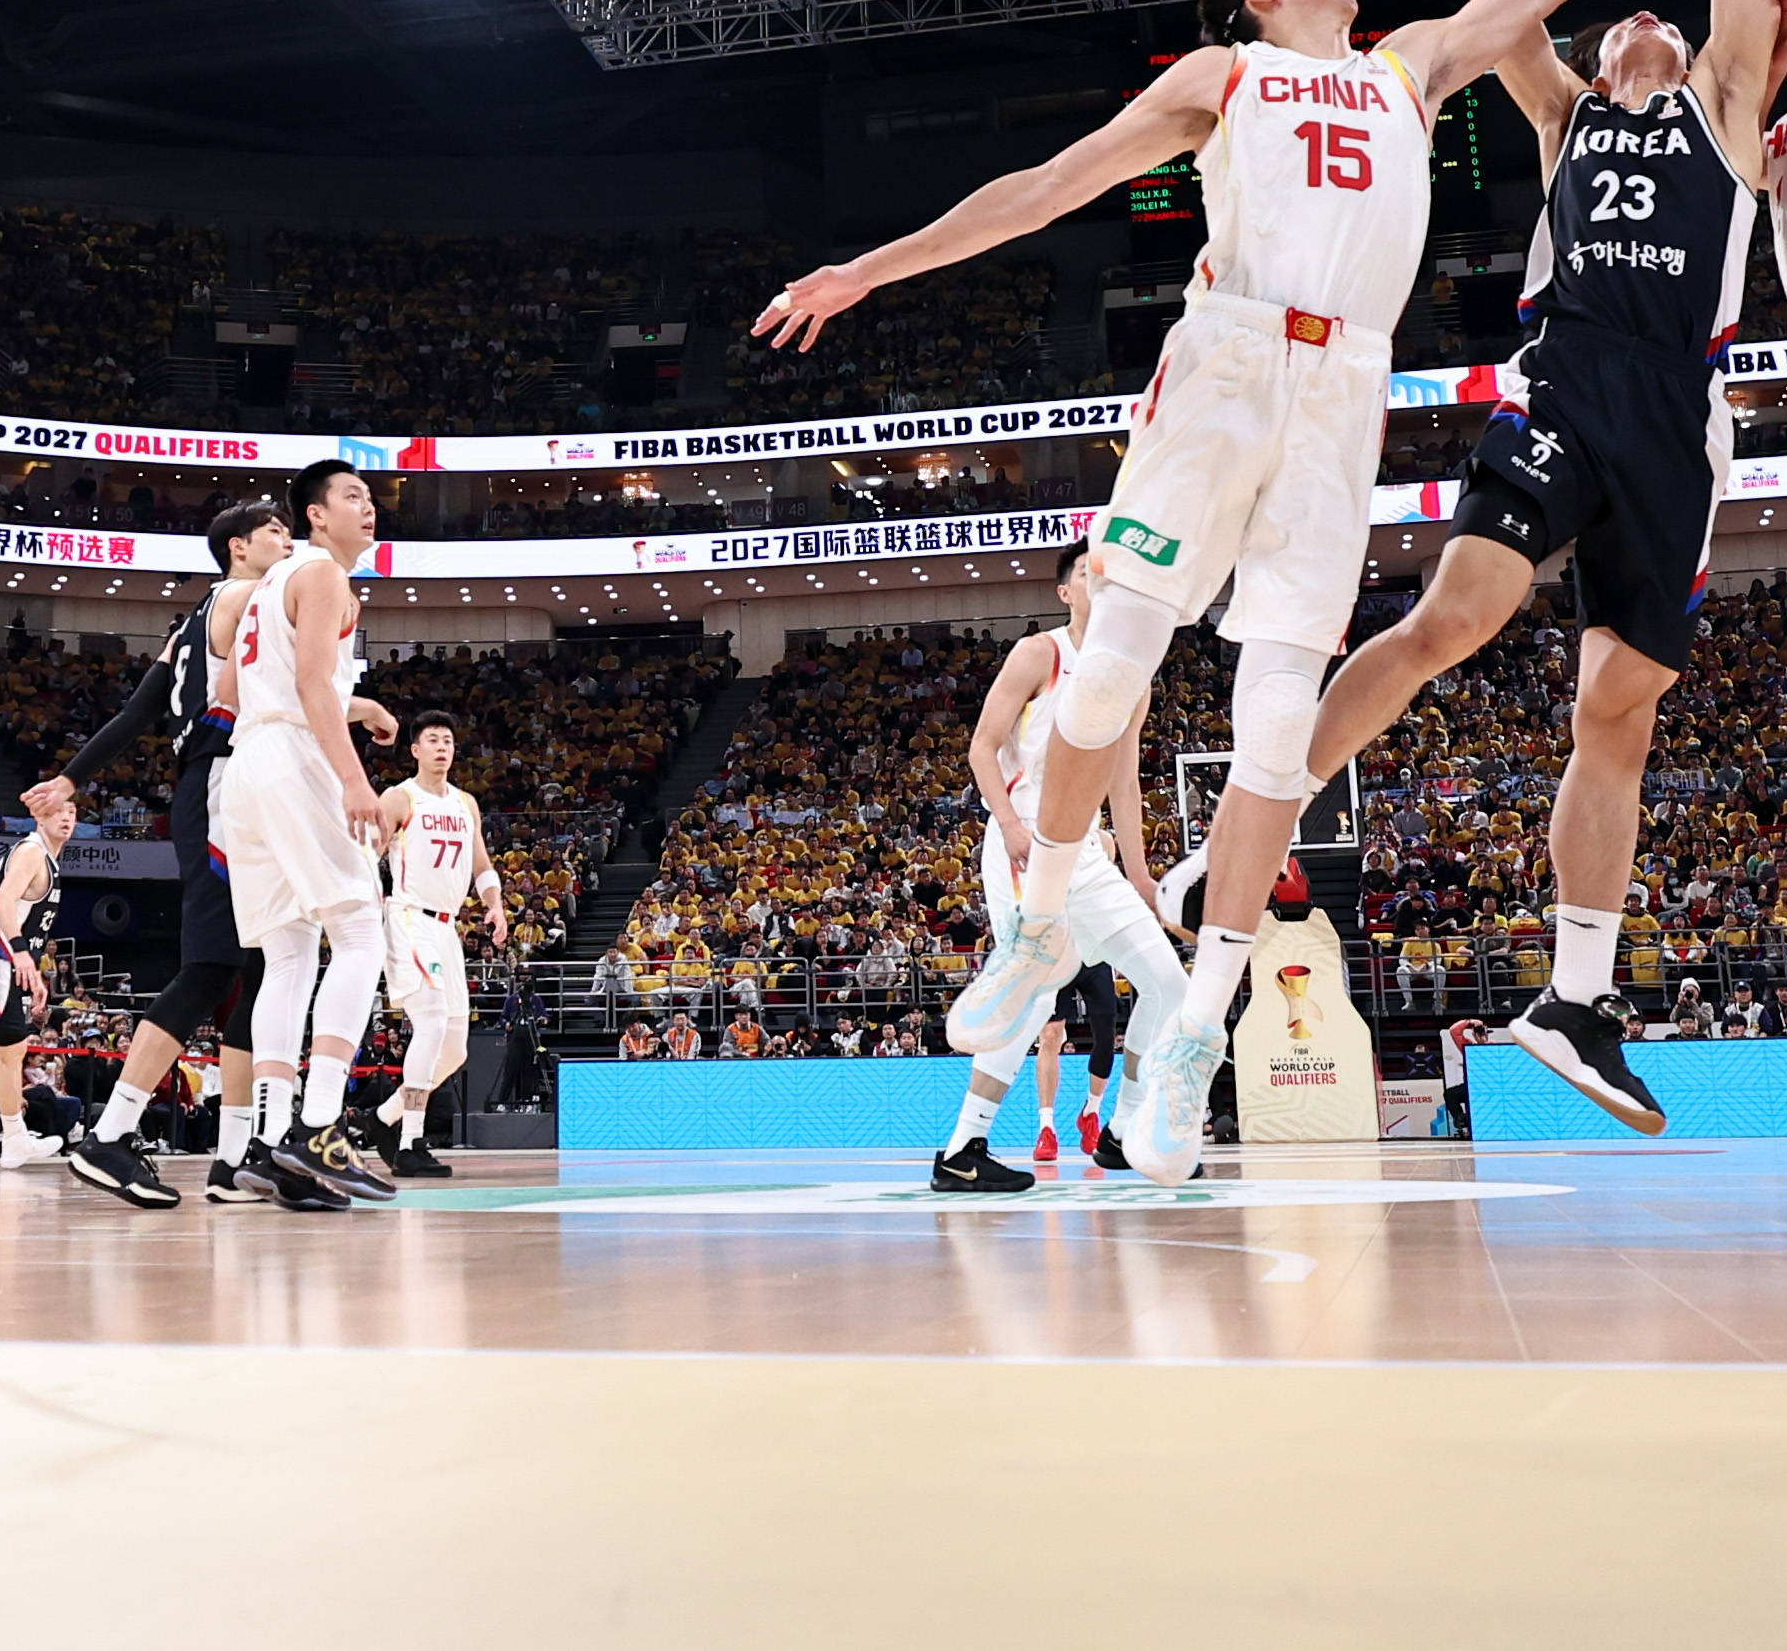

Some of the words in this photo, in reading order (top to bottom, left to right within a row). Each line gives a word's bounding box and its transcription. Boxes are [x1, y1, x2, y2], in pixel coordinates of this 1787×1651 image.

[1259, 73, 1390, 113] CHINA
[1464, 88, 1471, 96] 2
[1466, 99, 1478, 107] 13
[1468, 122, 1475, 131] 0
[1469, 134, 1476, 142] 0
[1571, 125, 1692, 161] KOREA
[1293, 121, 1373, 192] 15
[1470, 146, 1477, 154] 0
[1471, 157, 1478, 166] 0
[1472, 169, 1480, 177] 0
[1474, 181, 1481, 189] 2
[1589, 169, 1657, 222] 23
[1591, 240, 1687, 276] 하나은행
[613, 438, 679, 460] FIBA
[685, 425, 867, 457] BASKETBALL
[873, 416, 973, 443] WORLD
[980, 410, 1041, 434] CUP
[1047, 403, 1123, 429] 2027
[14, 425, 88, 450] 2027
[94, 432, 259, 461] QUALIFIERS
[1054, 482, 1074, 497] 47
[788, 502, 807, 517] 48
[711, 510, 1100, 563] 2027国际篮联篮球世界杯预
[422, 814, 468, 833] CHINA
[62, 845, 121, 864] 颜中心
[431, 839, 463, 870] 77
[1270, 1062, 1311, 1073] WORLD
[1312, 1062, 1336, 1072] CUP
[1270, 1072, 1337, 1087] QUALIFIERS
[1387, 1095, 1434, 1105] QUALIFIERS
